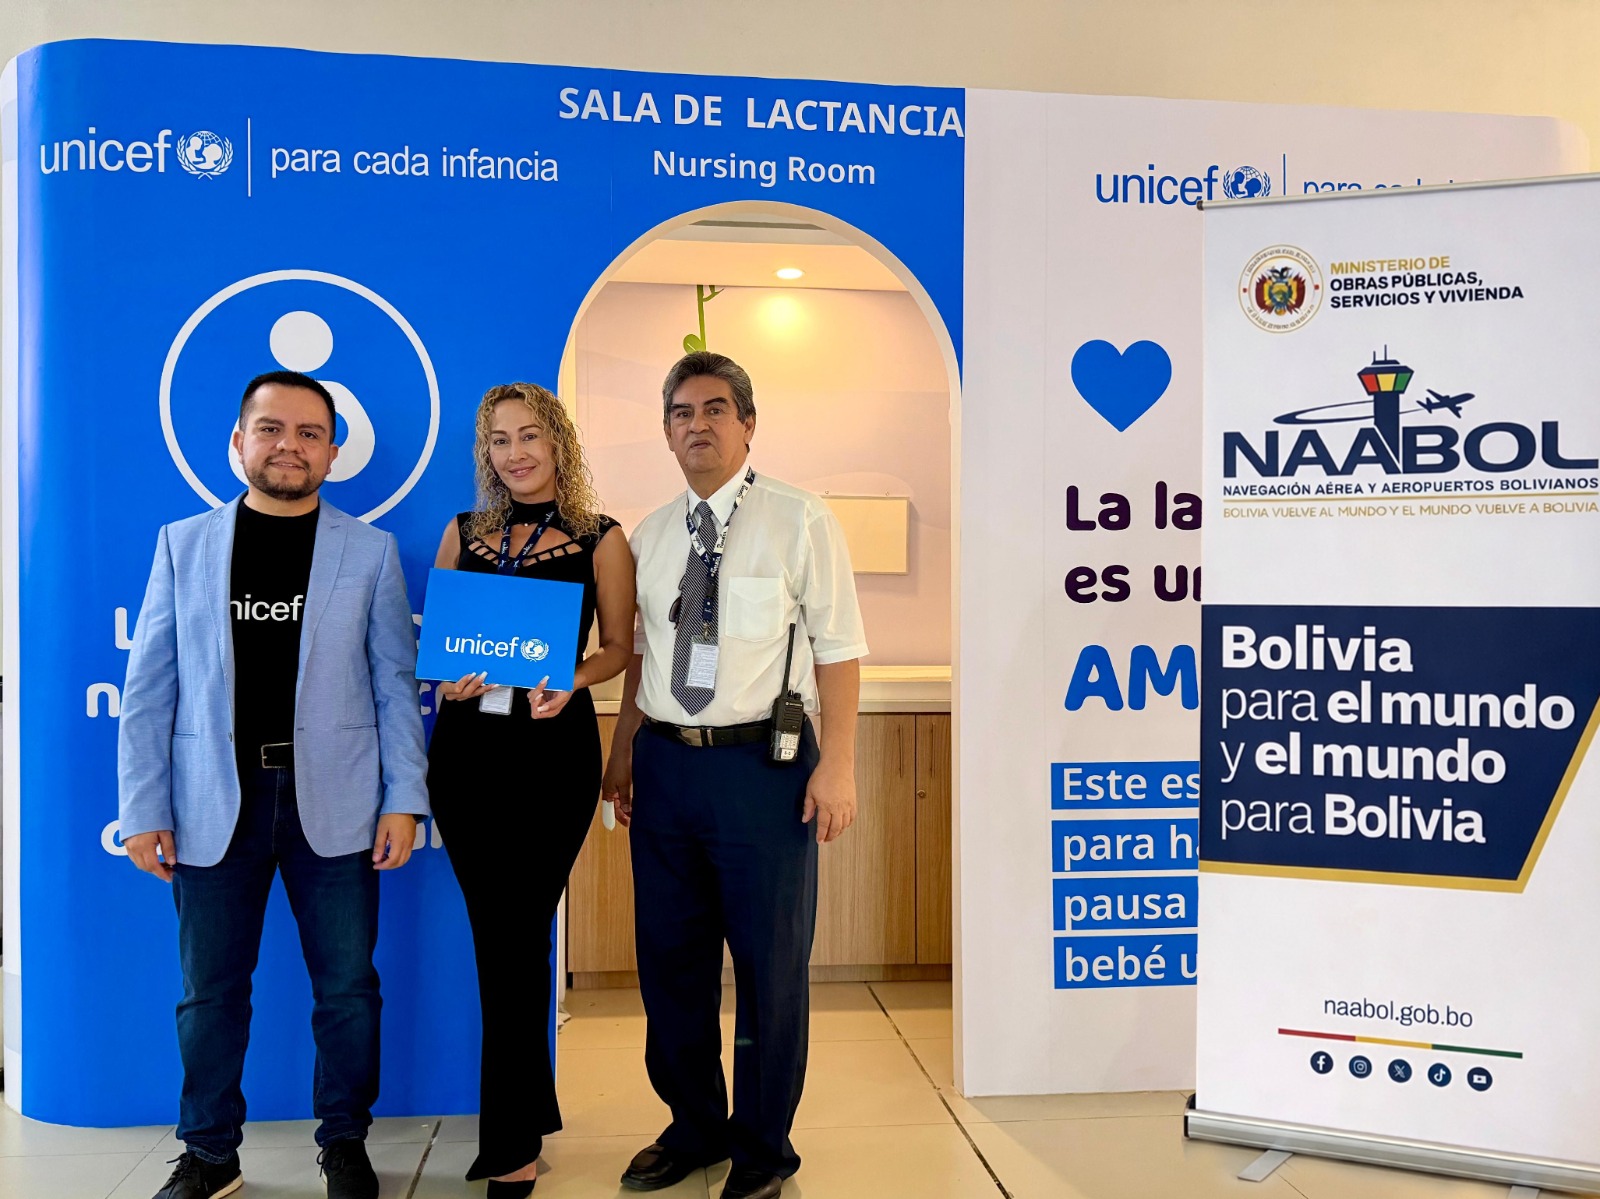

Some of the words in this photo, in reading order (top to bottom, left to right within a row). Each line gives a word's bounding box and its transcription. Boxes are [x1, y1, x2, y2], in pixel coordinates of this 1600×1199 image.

[560, 88, 661, 123] SALA
[675, 94, 721, 126] DE
[747, 97, 965, 138] LACTANCIA
[41, 127, 171, 174] unicef
[272, 148, 340, 178] para
[354, 146, 429, 176] cada
[443, 147, 558, 181] infancia
[654, 151, 776, 187] Nursing
[789, 157, 874, 184] Room
[1096, 164, 1218, 206] unicef
[1330, 258, 1425, 275] MINISTERIO
[1429, 256, 1450, 269] DE
[1331, 277, 1388, 291] OBRAS
[1392, 272, 1482, 288] PÚBLICAS,
[1331, 292, 1420, 308] SERVICIOS
[1425, 291, 1435, 303] Y
[1439, 287, 1523, 303] VIVIENDA
[1223, 420, 1599, 478] NAABOL
[1224, 482, 1310, 495] NAVEGACIÓN
[1315, 482, 1363, 494] AÉREA
[1368, 483, 1376, 493] Y
[1382, 481, 1494, 493] AEROPUERTOS
[1501, 478, 1598, 490] BOLIVIANOS
[1067, 486, 1130, 530] La
[1224, 508, 1269, 518] BOLIVIA
[1272, 507, 1316, 517] VUELVE
[1319, 507, 1333, 517] AL
[1338, 506, 1387, 516] MUNDO
[1389, 506, 1399, 515] Y
[1403, 506, 1415, 516] EL
[1420, 504, 1471, 515] MUNDO
[1476, 503, 1525, 514] VUELVE
[1529, 503, 1539, 513] A
[1544, 502, 1599, 513] BOLIVIA
[1065, 565, 1130, 603] es
[445, 633, 519, 658] unicef
[1223, 625, 1413, 672] Bolivia
[1223, 689, 1318, 728] para
[1328, 681, 1371, 723] el
[1381, 684, 1575, 730] mundo
[1220, 742, 1245, 782] y
[1255, 732, 1300, 774] el
[1313, 738, 1505, 783] mundo
[1064, 768, 1146, 800] Este
[1222, 800, 1314, 839] para
[1326, 794, 1485, 843] Bolivia
[1064, 834, 1154, 871] para
[1065, 892, 1186, 930] pausa
[1066, 945, 1165, 981] bebé
[1325, 998, 1472, 1027] naabol.gob.bo
